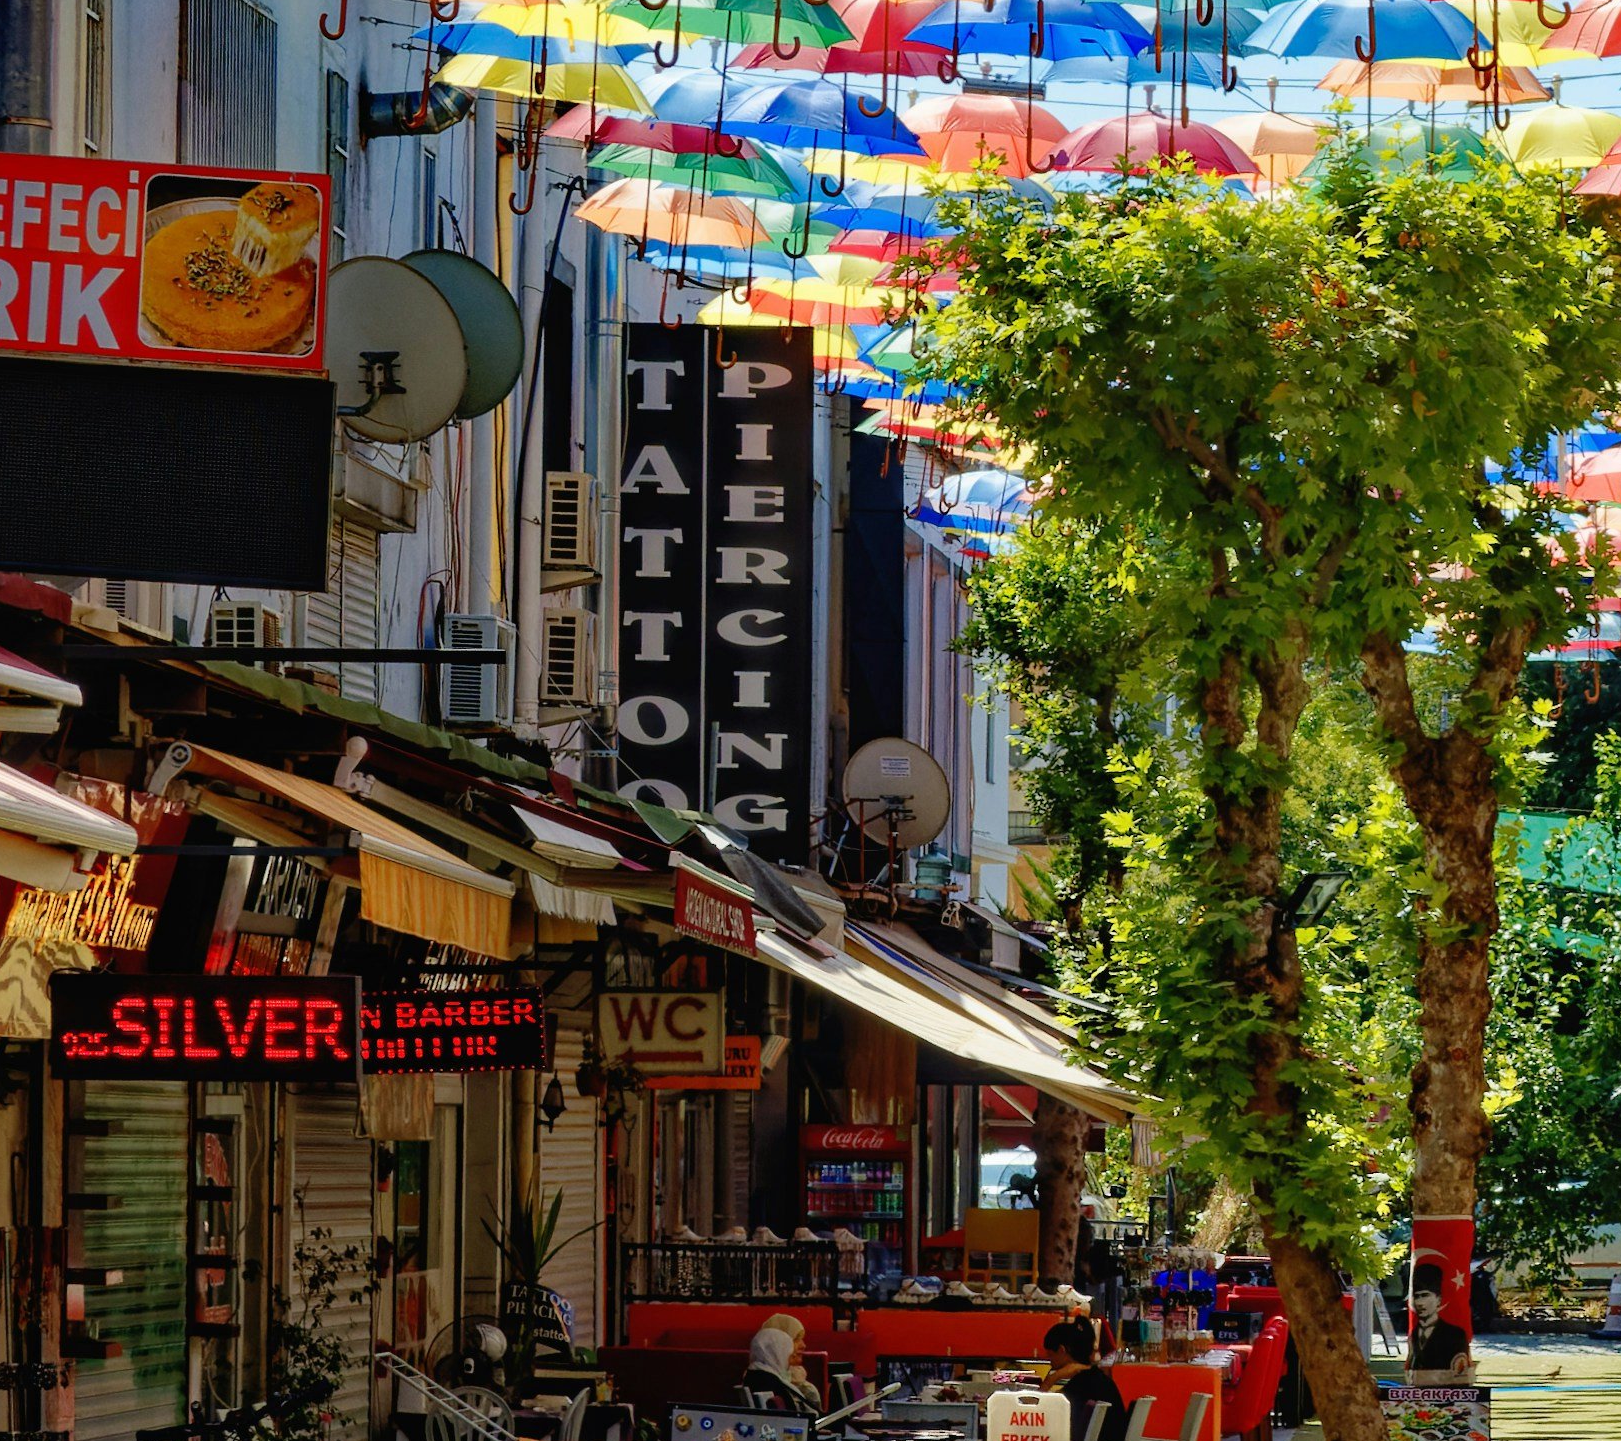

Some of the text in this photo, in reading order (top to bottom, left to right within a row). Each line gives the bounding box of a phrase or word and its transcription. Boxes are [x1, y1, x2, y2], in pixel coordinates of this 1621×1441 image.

[618, 359, 793, 833] TATTOO PIERCING
[112, 997, 351, 1060] SILVER
[397, 998, 538, 1029] BARBER
[609, 996, 708, 1042] WC
[1218, 1329, 1239, 1342] EFES
[1388, 1388, 1480, 1404] BREAKFAST
[1010, 1411, 1045, 1427] AKIN
